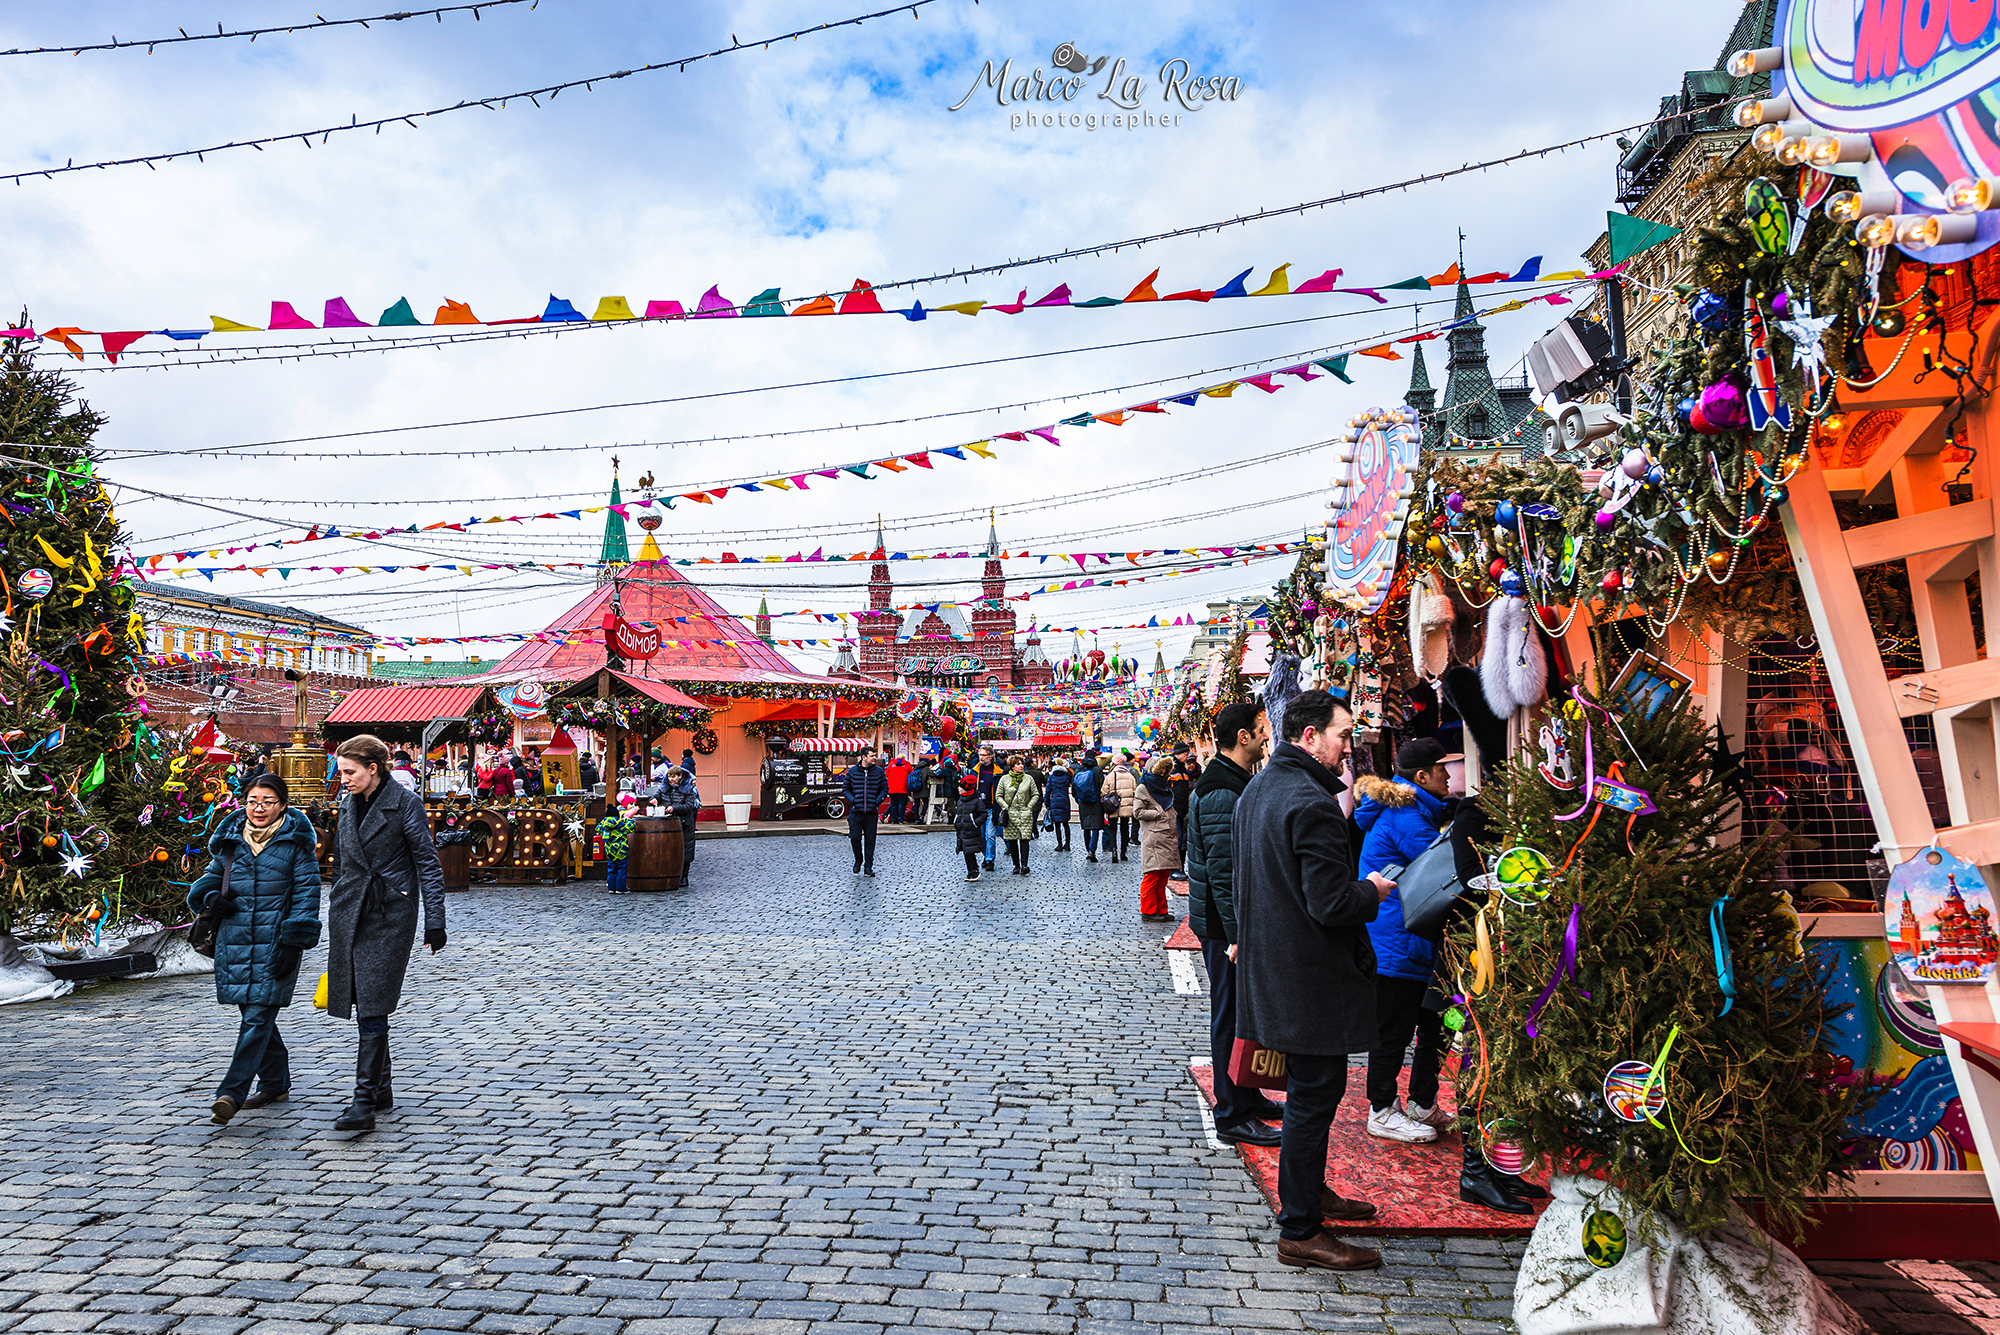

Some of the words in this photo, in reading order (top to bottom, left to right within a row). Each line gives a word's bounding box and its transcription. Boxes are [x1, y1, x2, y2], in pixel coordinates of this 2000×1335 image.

[616, 623, 658, 654] ДЫМОВ
[1040, 722, 1075, 731] ДЫМОВ
[1914, 965, 1983, 981] МОСКВА
[1251, 1049, 1287, 1078] ГУМ
